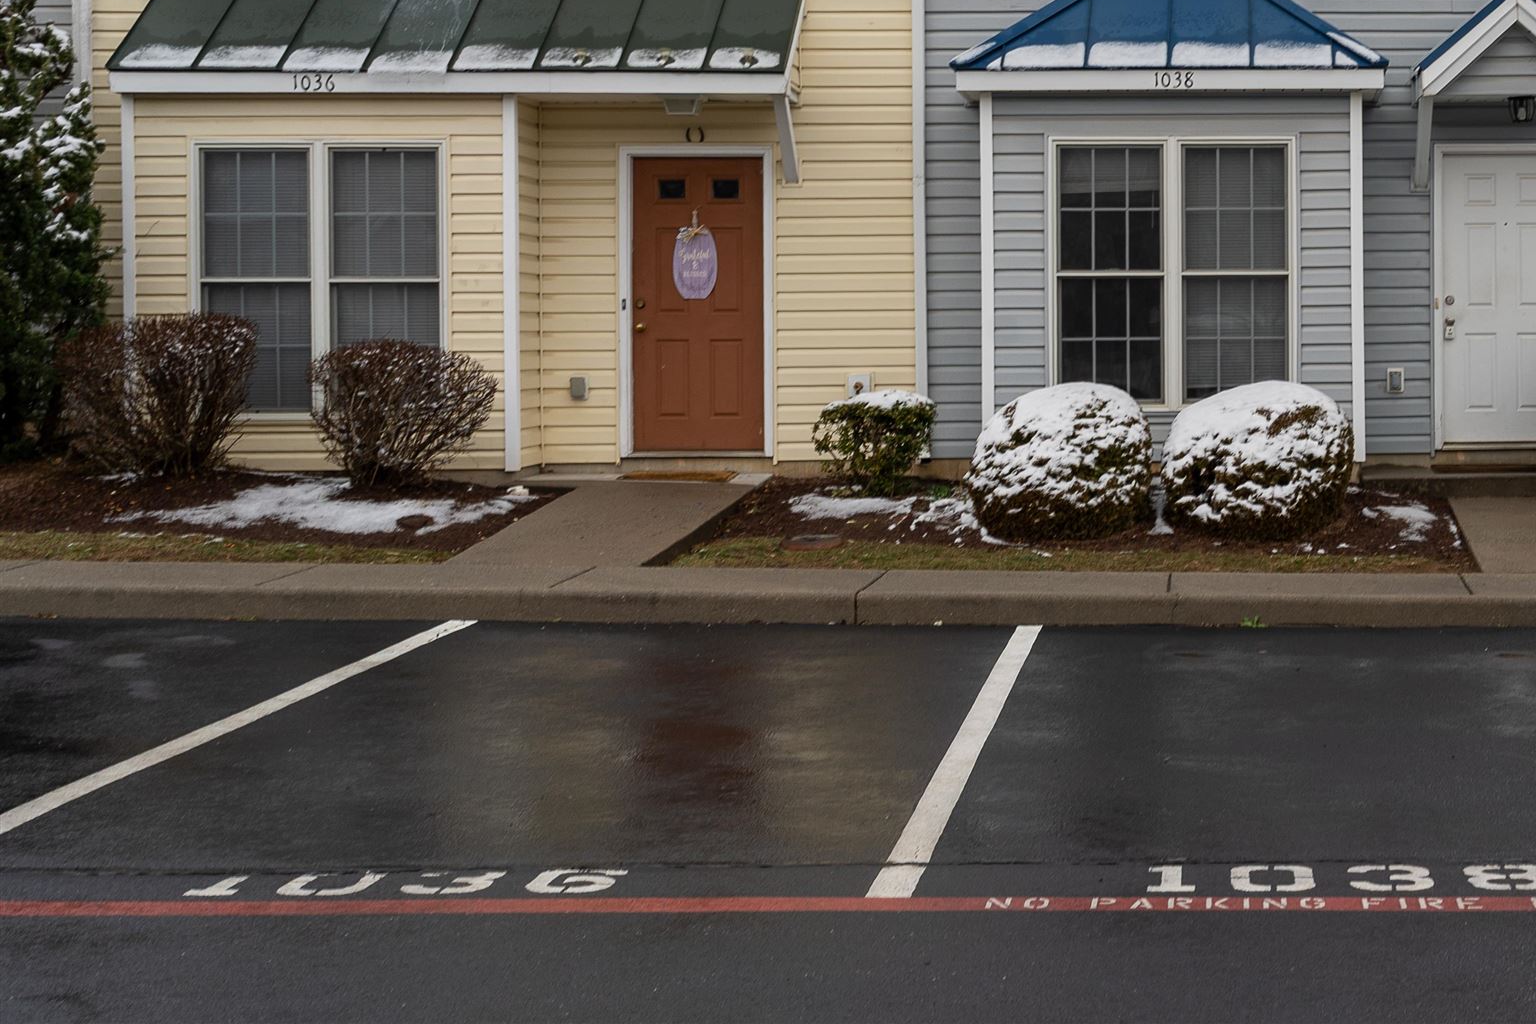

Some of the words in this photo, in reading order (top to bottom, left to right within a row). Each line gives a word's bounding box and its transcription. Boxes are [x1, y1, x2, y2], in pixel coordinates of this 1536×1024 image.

[293, 73, 335, 92] 1036
[1154, 71, 1194, 88] 1038
[183, 869, 629, 897] 1036
[985, 897, 1050, 910] NO
[1090, 897, 1326, 910] PARKING
[1361, 896, 1484, 910] FIRE
